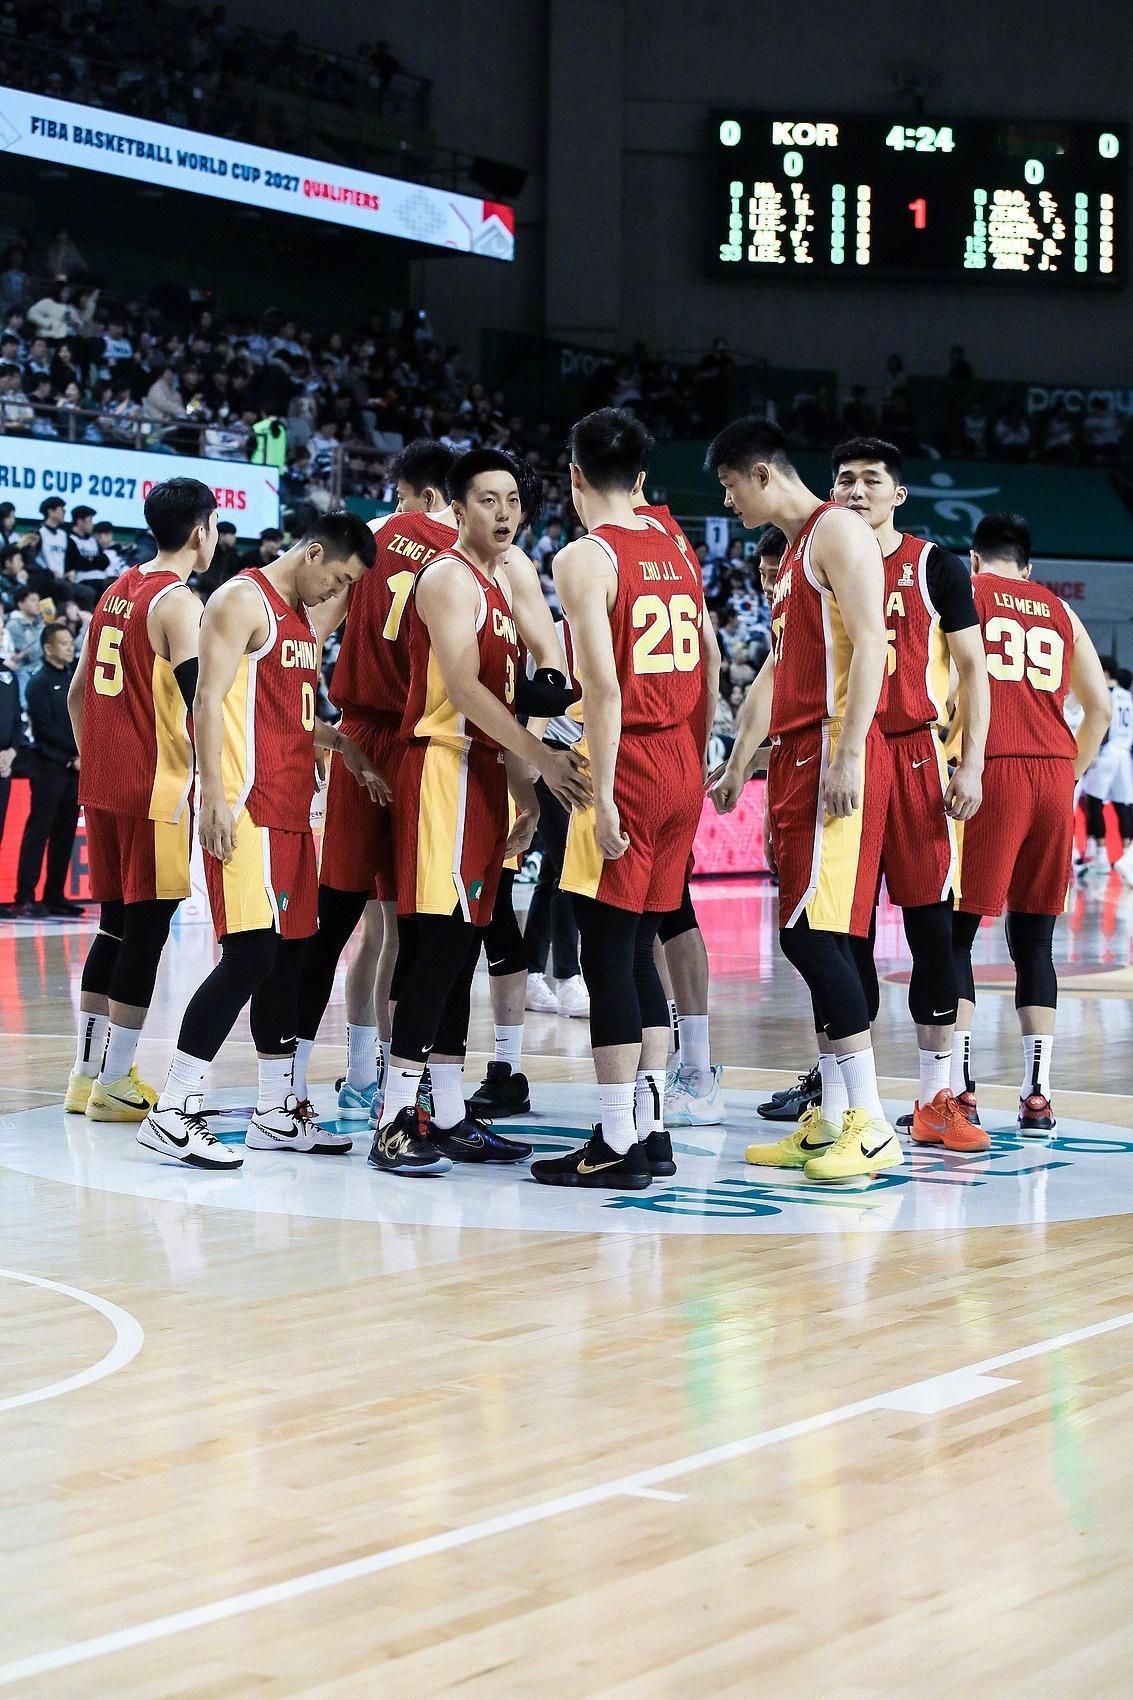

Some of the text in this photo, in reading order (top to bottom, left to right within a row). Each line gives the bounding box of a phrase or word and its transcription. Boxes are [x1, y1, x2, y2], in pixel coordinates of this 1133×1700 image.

[719, 120, 741, 147] 0
[772, 121, 838, 147] KOR
[885, 125, 955, 152] 4:24
[1098, 133, 1120, 159] 0
[30, 116, 380, 211] FIBA BASKETBALL WORLD CUP 2027 QUALIFIERS
[783, 151, 804, 178] 0
[1024, 159, 1045, 185] 0
[908, 198, 927, 230] 1
[43, 469, 82, 494] CUP
[89, 473, 137, 499] 2027
[386, 533, 426, 561] ZENG
[638, 561, 662, 581] ZHU
[103, 594, 128, 615] LIAO
[382, 570, 416, 642] 1
[993, 592, 1051, 618] LEI MENG
[632, 594, 700, 675] 26
[93, 625, 125, 698] 5
[985, 616, 1065, 694] 39
[504, 653, 515, 705] 3
[301, 681, 315, 732] 0
